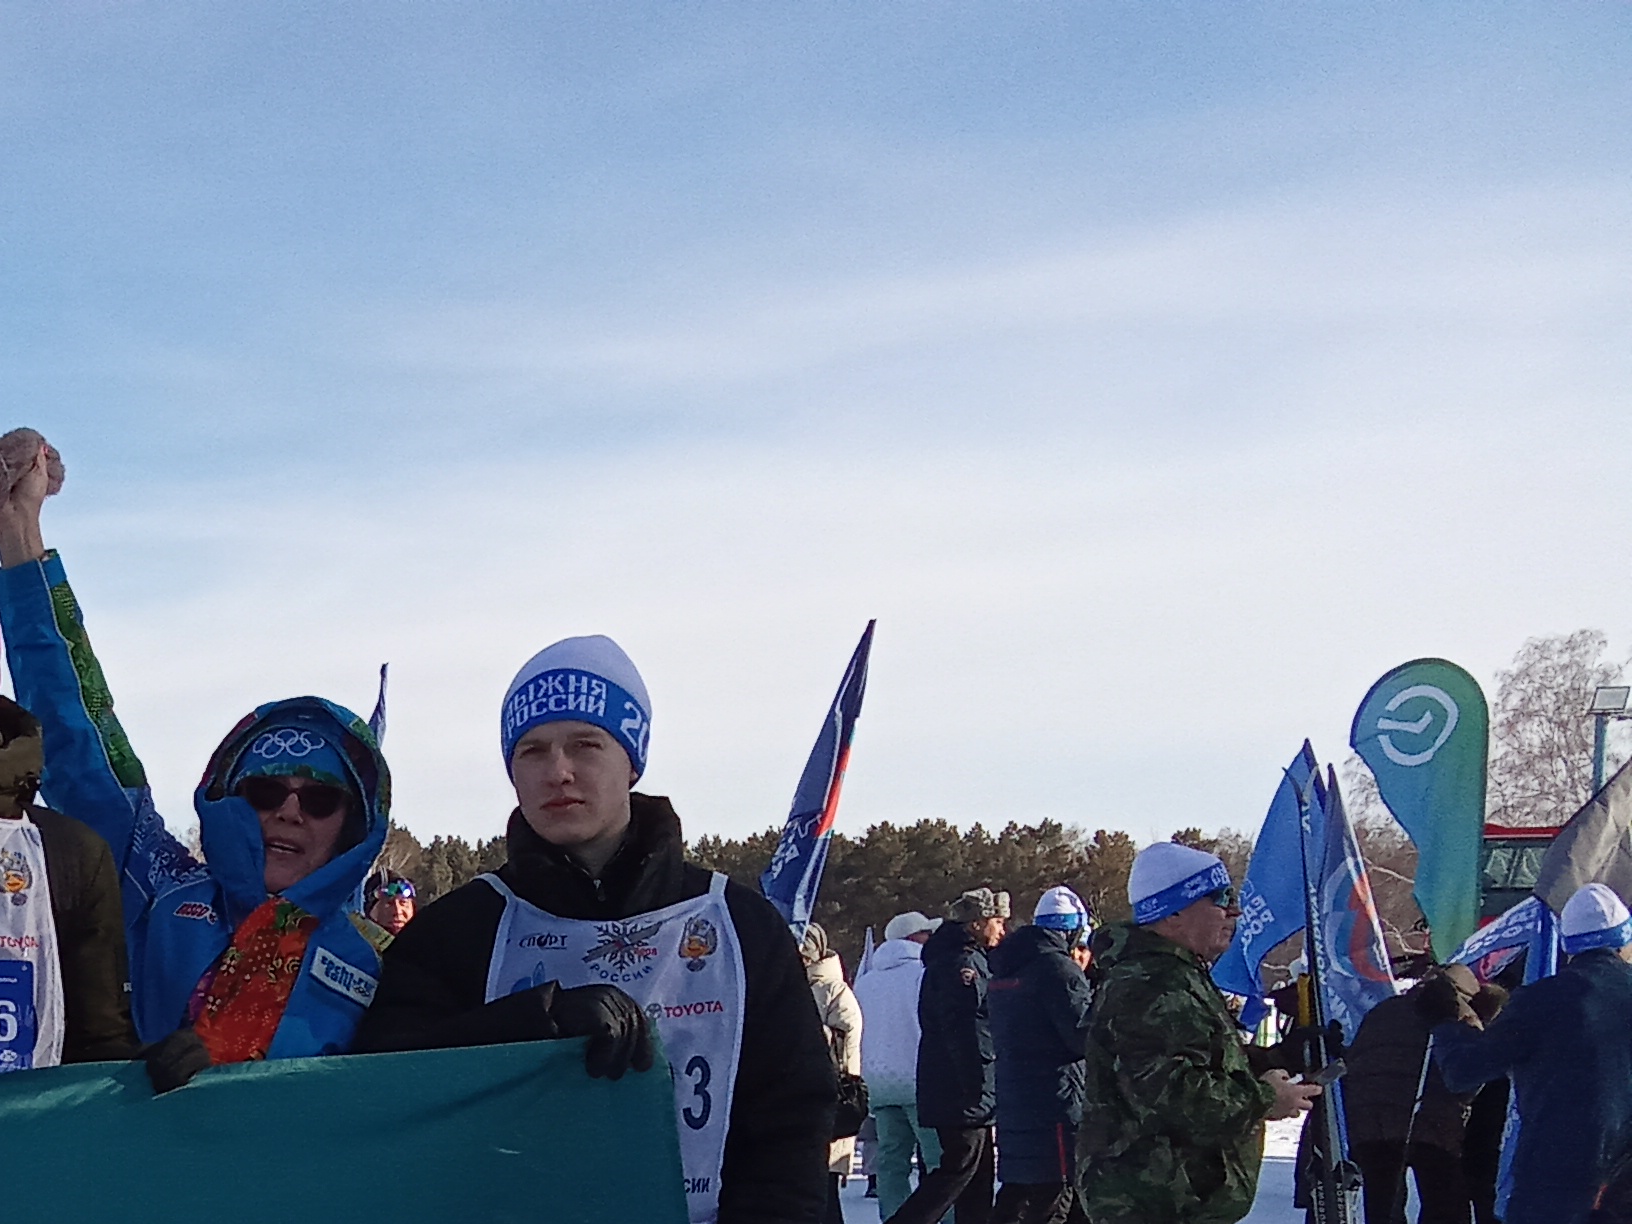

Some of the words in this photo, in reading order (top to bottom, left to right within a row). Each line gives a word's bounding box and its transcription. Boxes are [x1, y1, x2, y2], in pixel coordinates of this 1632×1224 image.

[506, 673, 607, 716] ЛЫЖНЯ
[506, 693, 606, 739] РОССИИ
[519, 932, 568, 949] СПОРТ
[1308, 881, 1327, 986] NORDWAY
[590, 963, 654, 983] РОССИИ
[663, 1000, 724, 1018] TOYOTA
